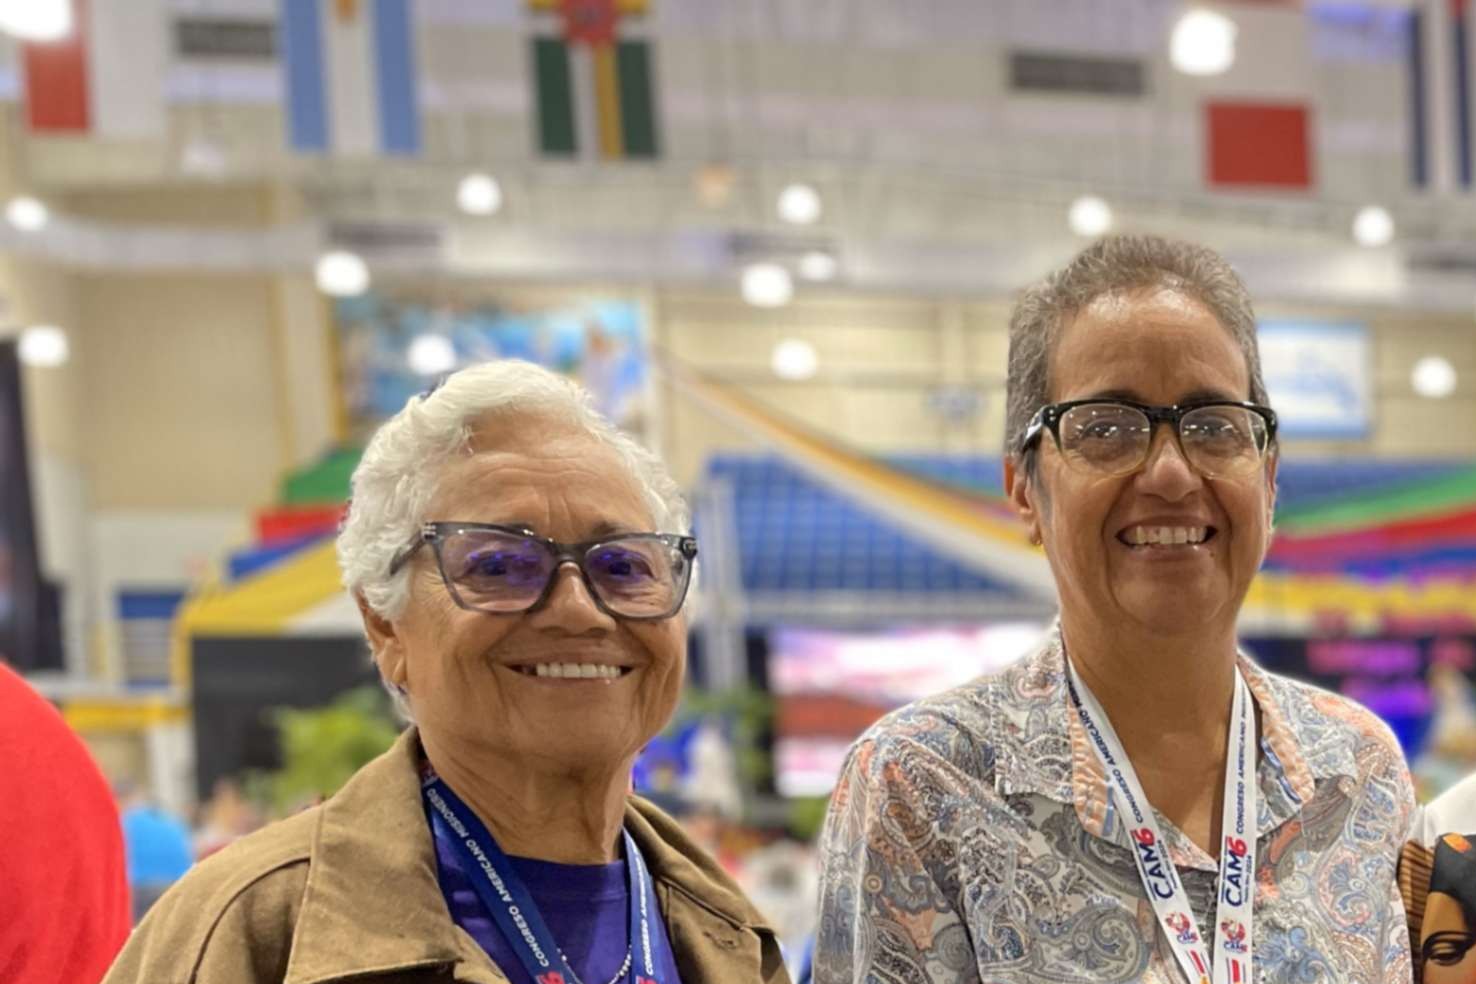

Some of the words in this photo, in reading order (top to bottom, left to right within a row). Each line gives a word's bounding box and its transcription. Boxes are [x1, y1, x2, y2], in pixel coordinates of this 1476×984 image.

[1079, 709, 1116, 766] AMERICANO
[1112, 768, 1144, 824] CONGRESO
[1236, 781, 1245, 834] CONGRESO
[466, 838, 513, 903] AMERICANO
[1132, 828, 1175, 899] CAM6
[1225, 836, 1248, 907] CAM6
[508, 905, 549, 967] CONGRESO
